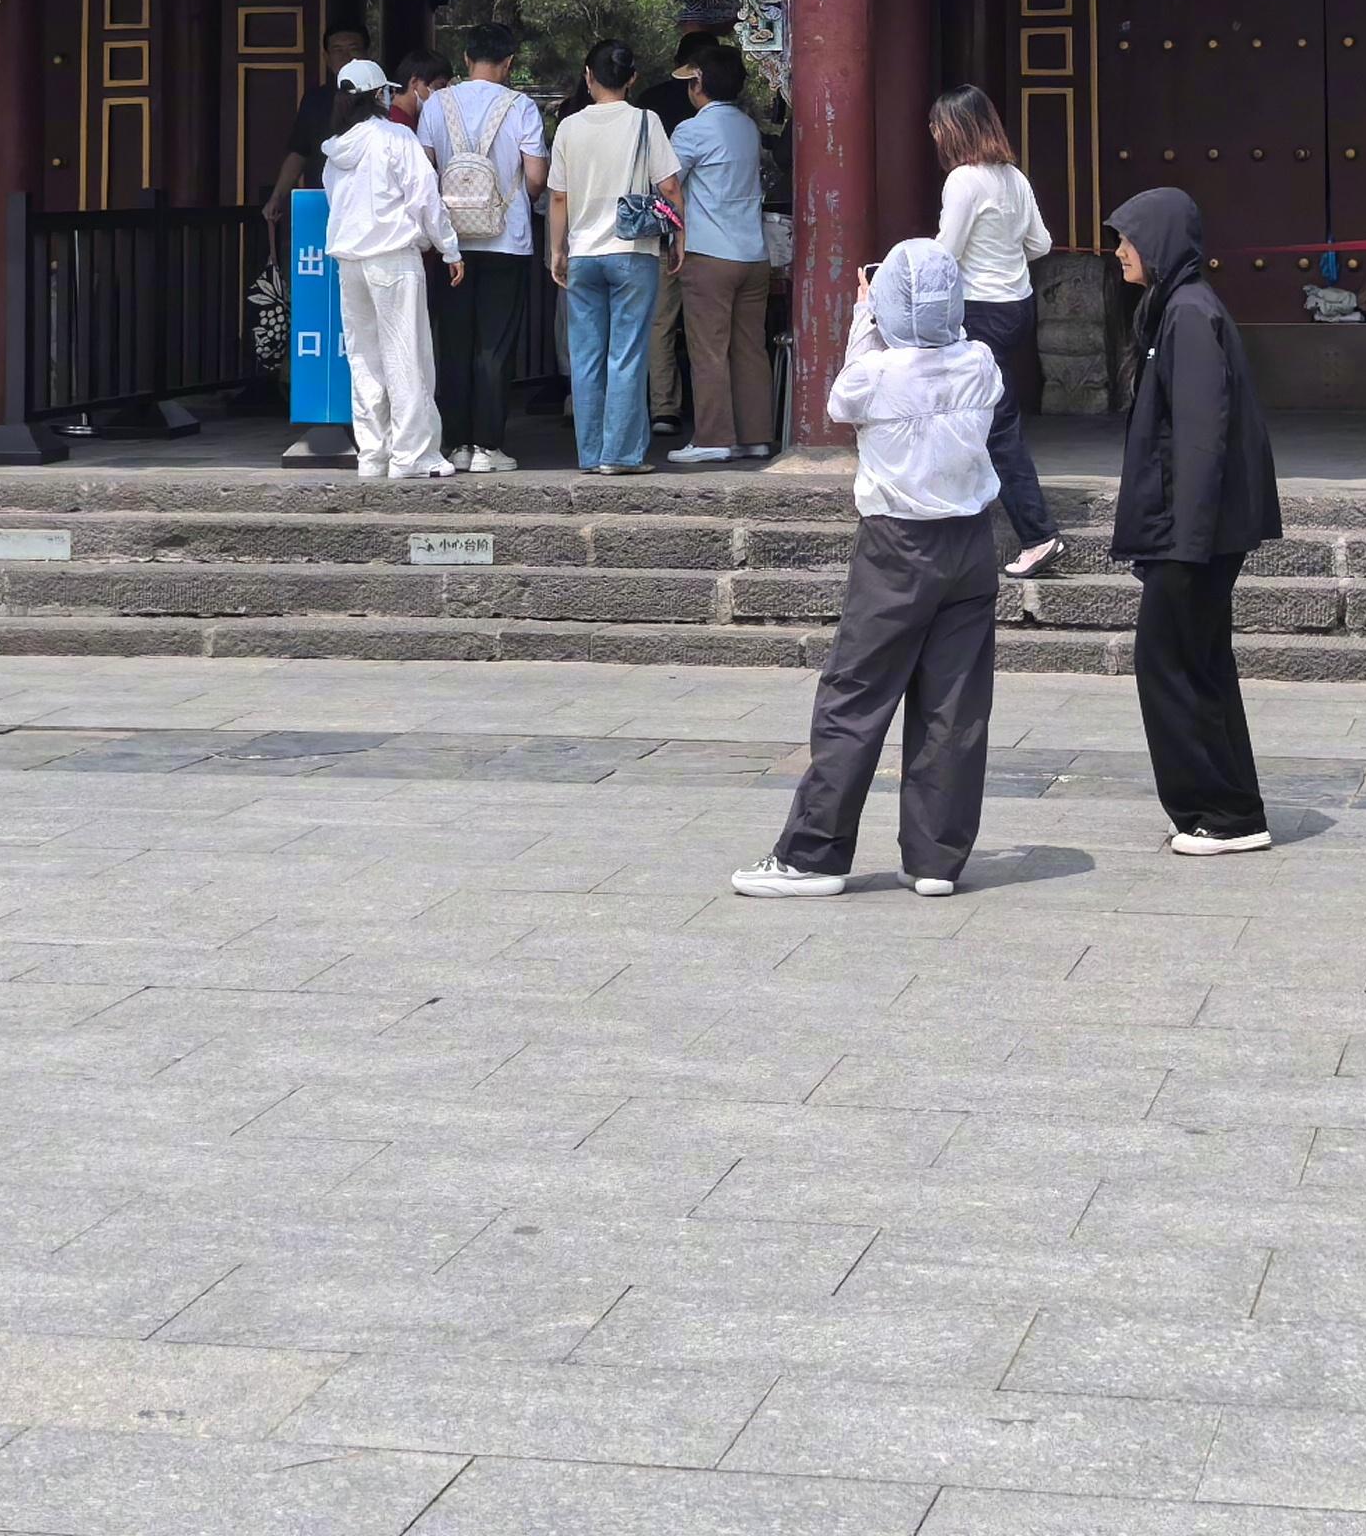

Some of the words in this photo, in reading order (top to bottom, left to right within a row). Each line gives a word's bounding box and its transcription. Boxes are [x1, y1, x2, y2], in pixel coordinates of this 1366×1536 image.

[298, 245, 325, 358] 出口
[439, 538, 489, 552] 小心台阶
